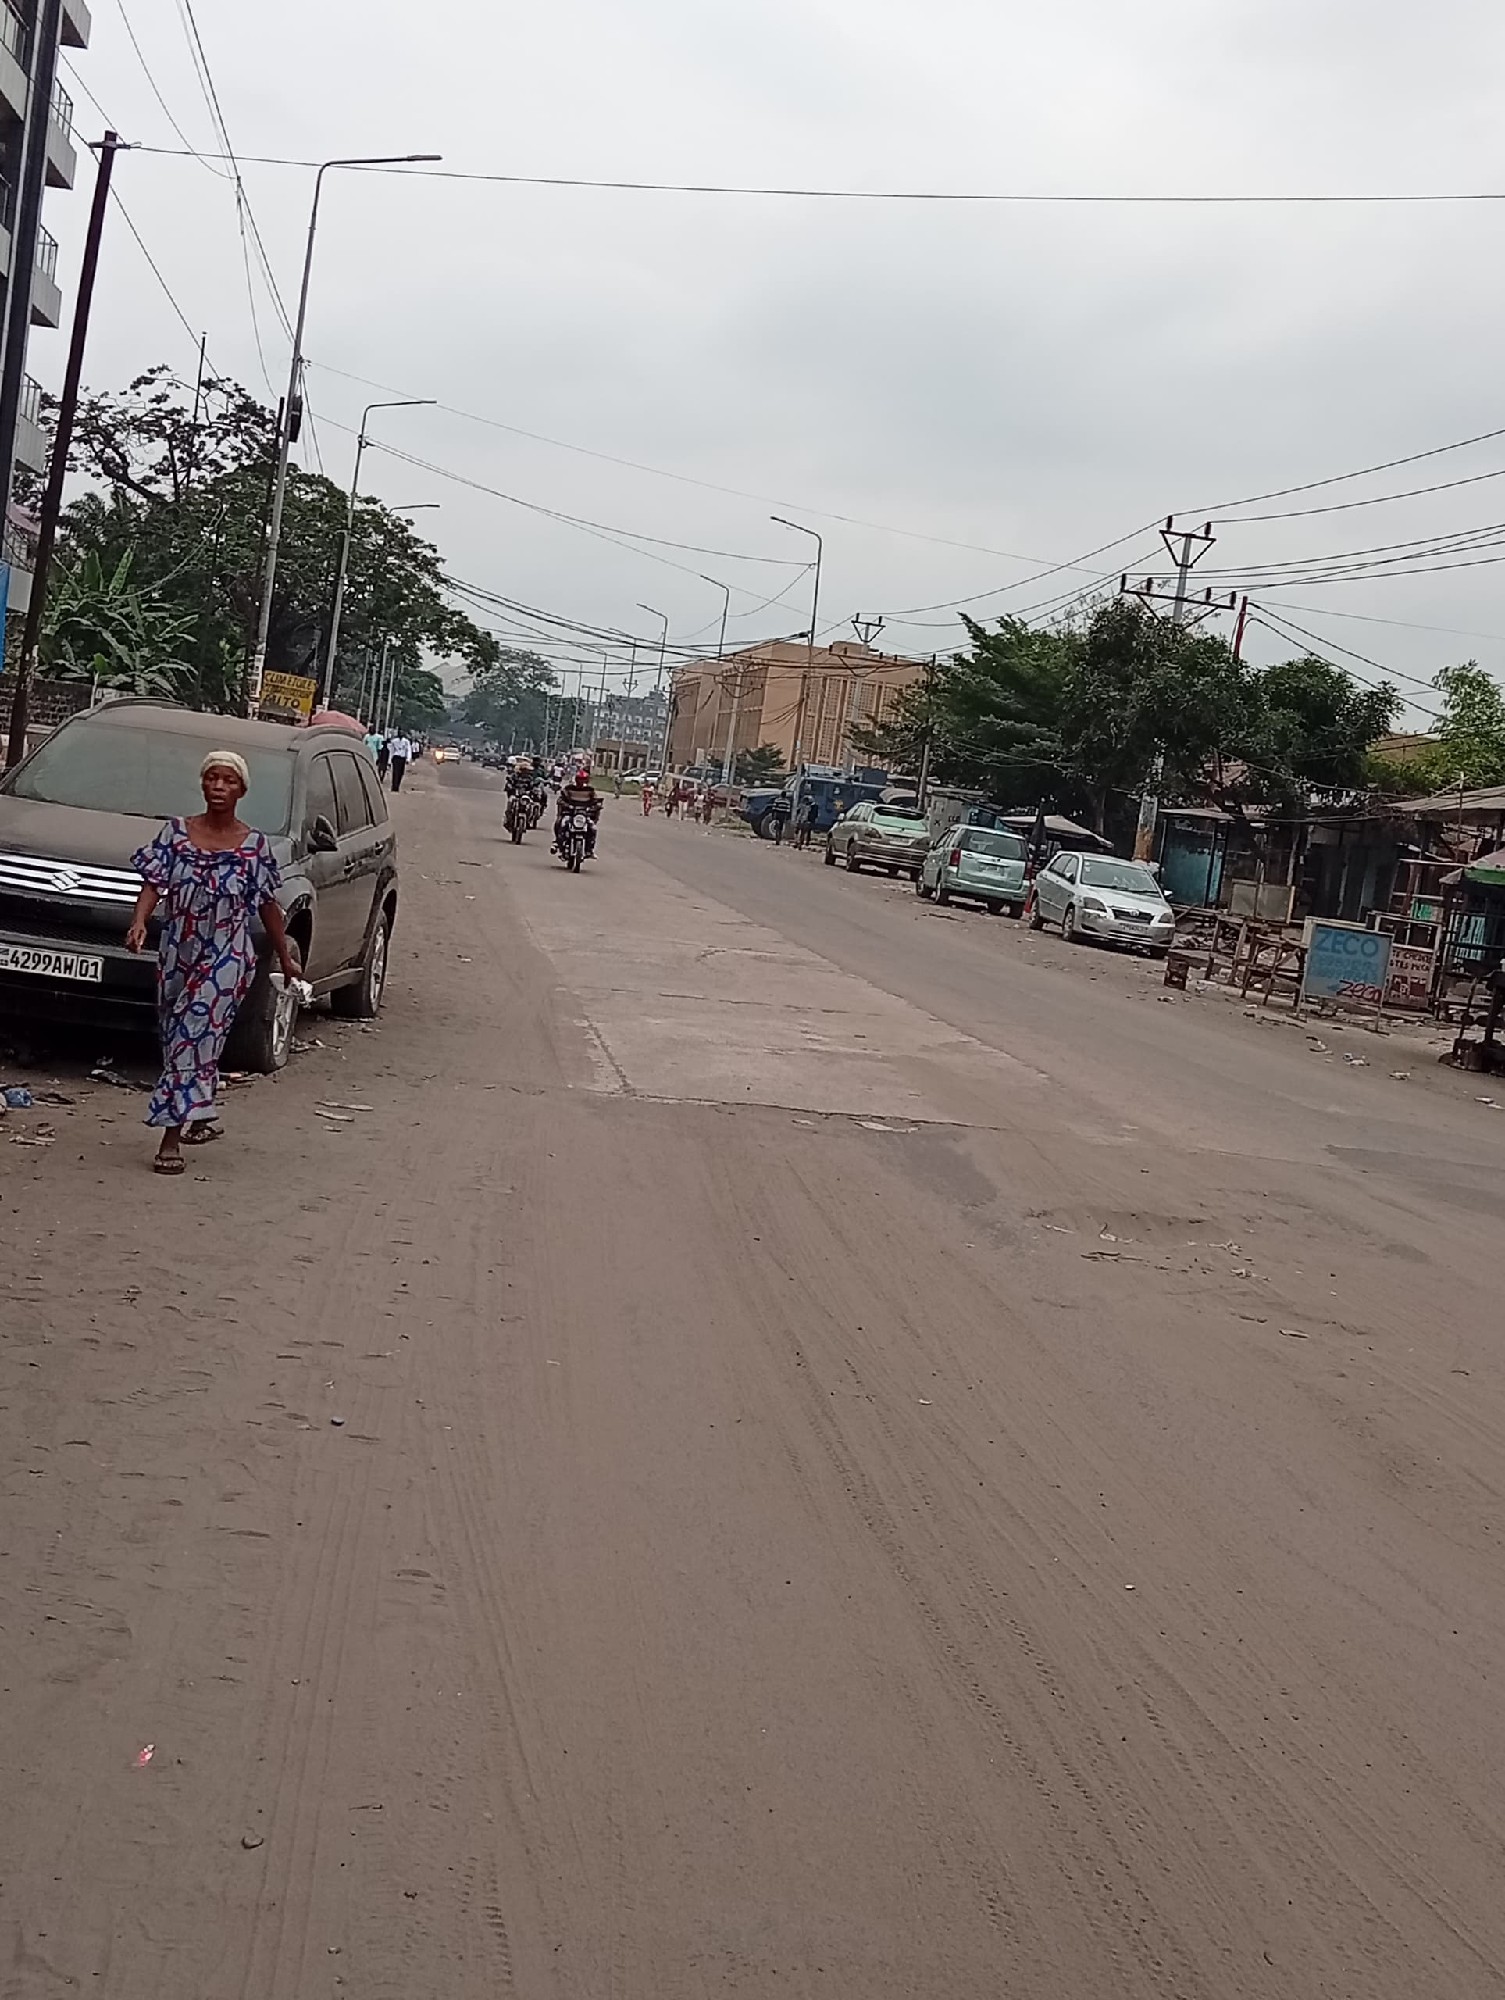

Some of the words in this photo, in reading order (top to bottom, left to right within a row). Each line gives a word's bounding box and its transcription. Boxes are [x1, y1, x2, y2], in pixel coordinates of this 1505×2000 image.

[263, 693, 300, 709] AUTO
[1315, 929, 1379, 957] ZECO
[79, 959, 99, 979] 01
